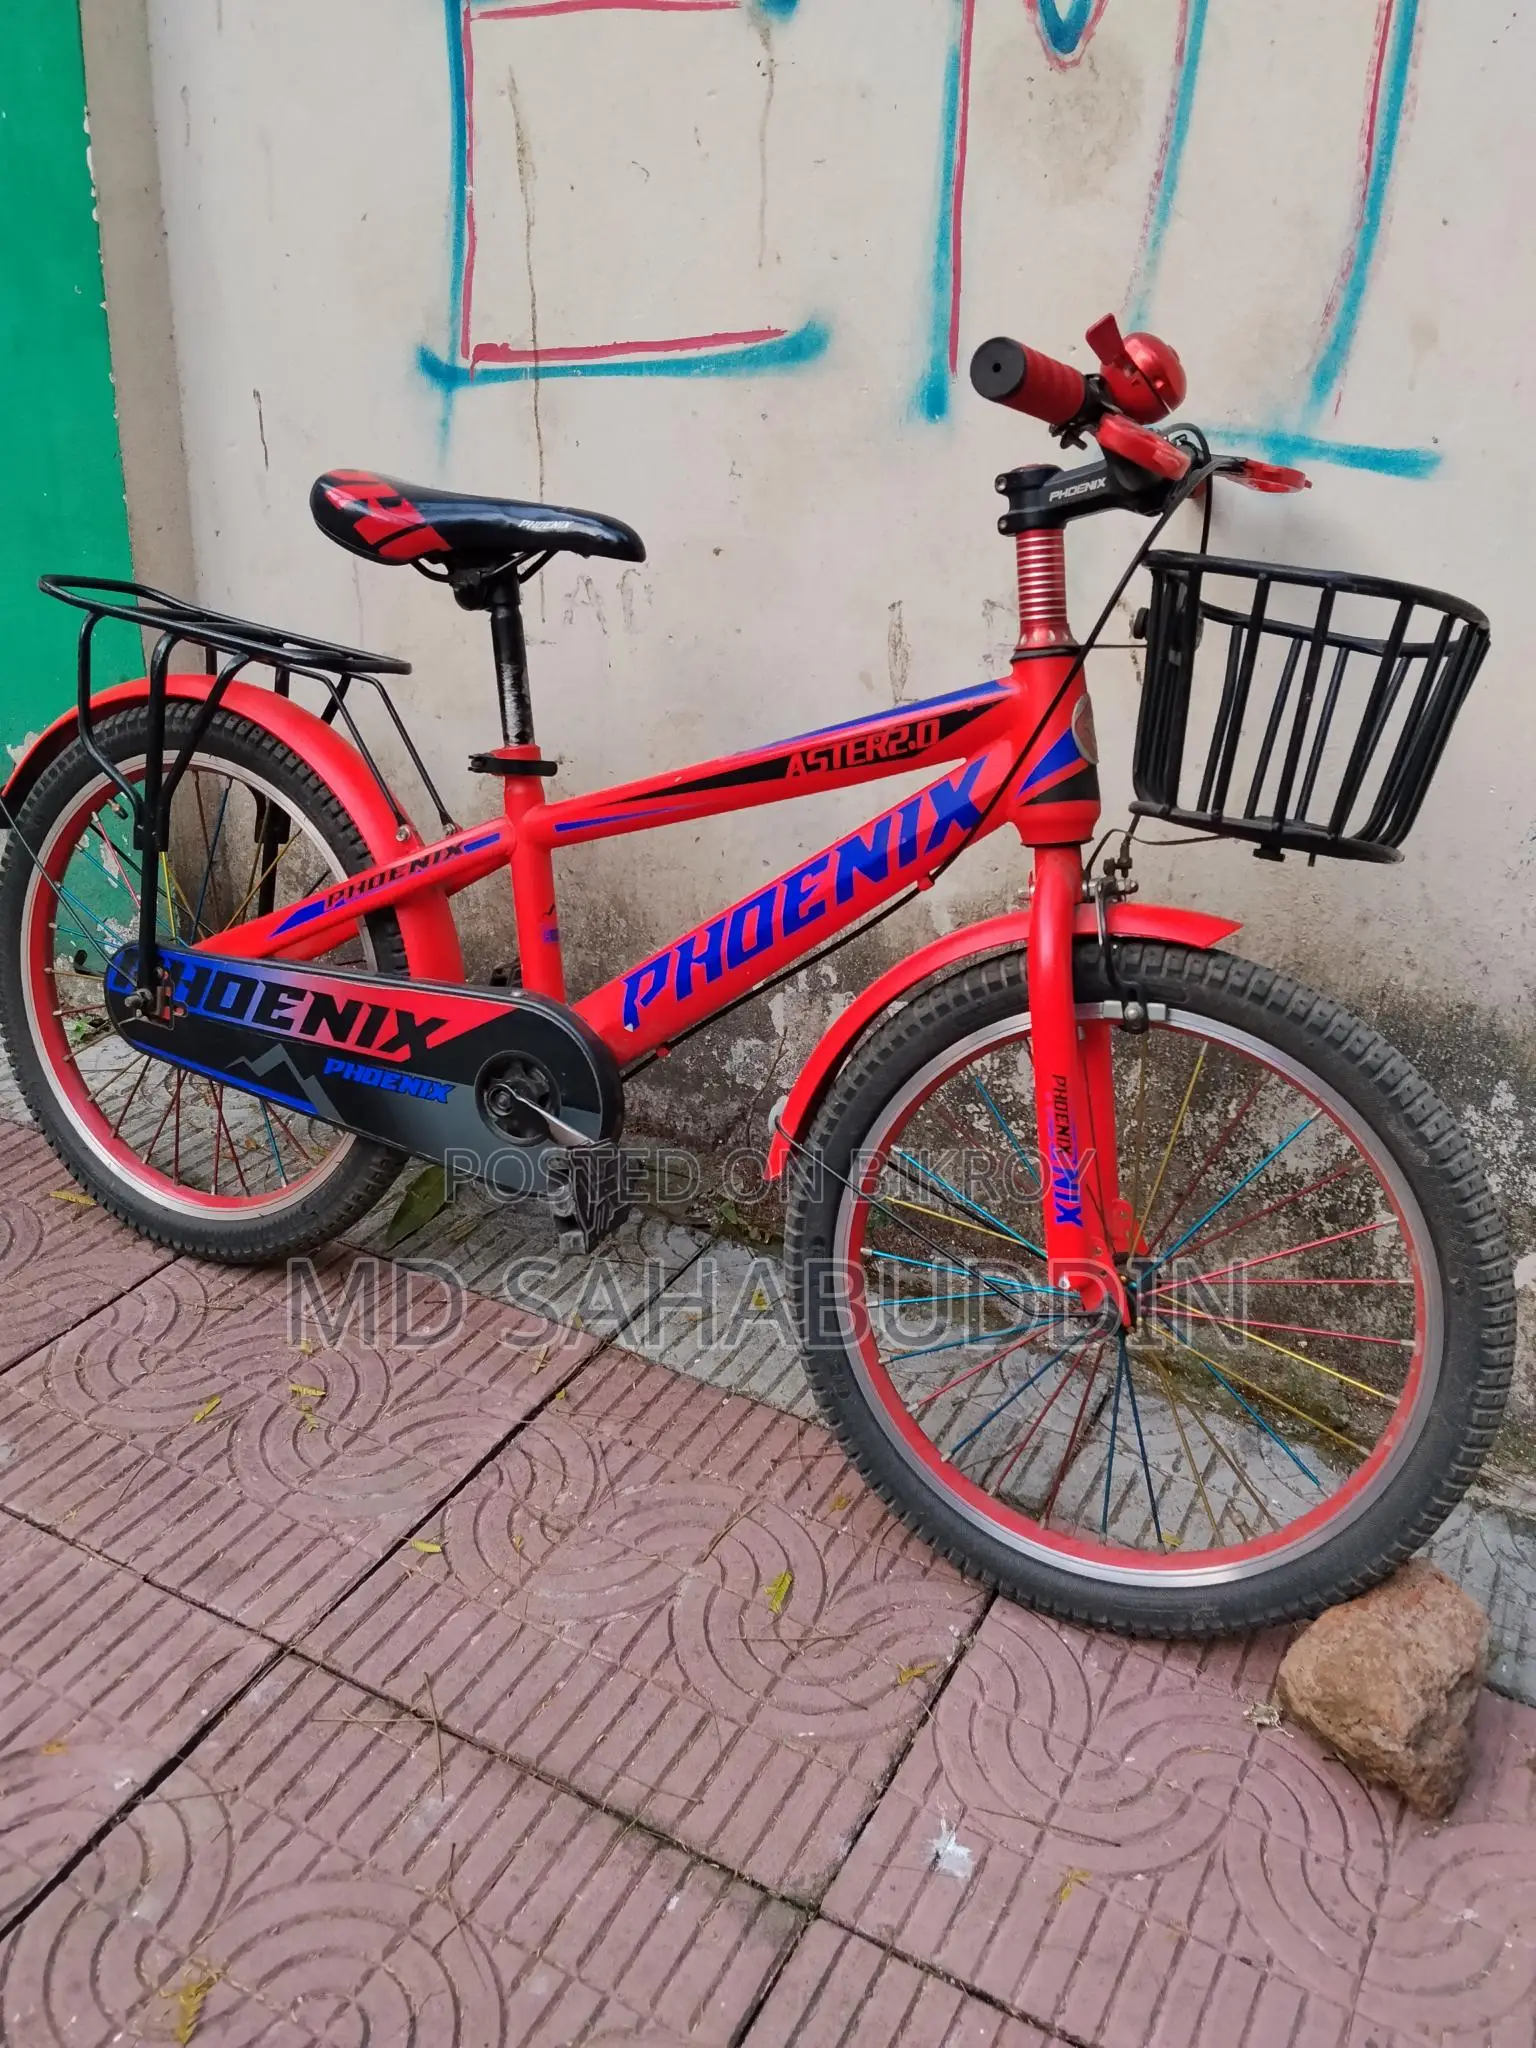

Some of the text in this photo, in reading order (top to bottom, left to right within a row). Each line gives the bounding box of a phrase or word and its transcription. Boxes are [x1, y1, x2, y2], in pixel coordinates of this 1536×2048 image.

[1049, 477, 1107, 503] PHOENIX
[518, 519, 574, 530] PHOENIX
[325, 840, 465, 909] PHOENIX
[622, 755, 988, 1032] PHOENIX
[323, 1058, 457, 1104] PHOENIX
[1052, 1074, 1071, 1154] PHOENIX
